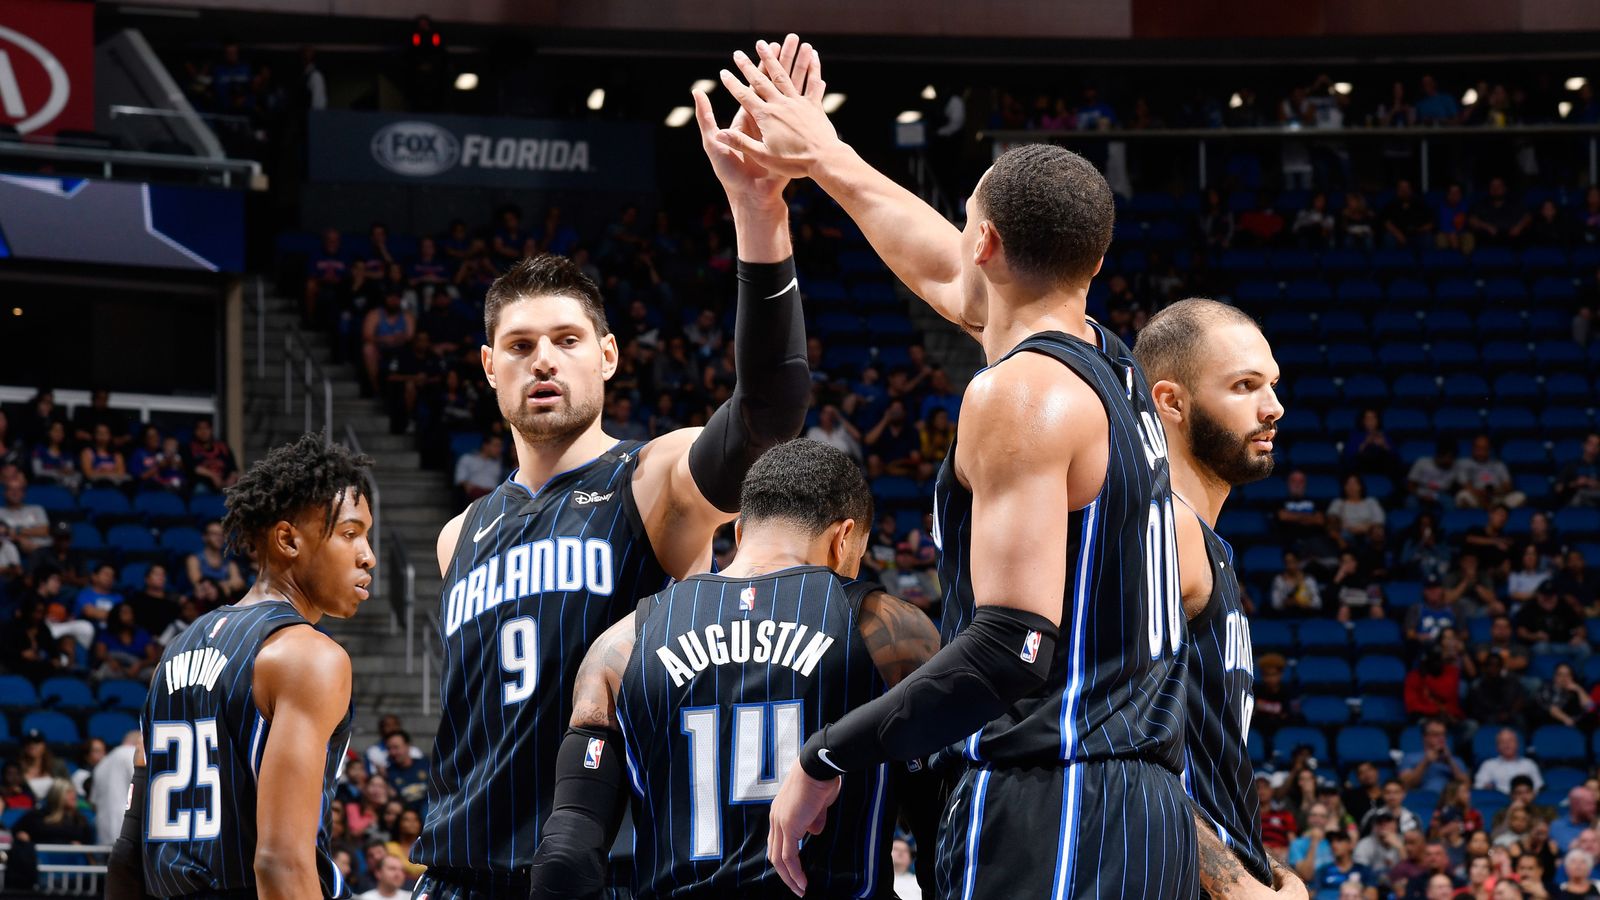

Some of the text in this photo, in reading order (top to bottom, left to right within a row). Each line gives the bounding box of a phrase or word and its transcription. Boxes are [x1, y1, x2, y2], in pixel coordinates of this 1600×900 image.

[391, 132, 438, 154] FOX
[461, 134, 590, 172] FLORIDA
[446, 536, 614, 638] ORLANDO
[501, 615, 538, 705] 9
[656, 619, 835, 688] AUGUSTIN
[146, 717, 221, 842] 25
[680, 699, 804, 861] 14
